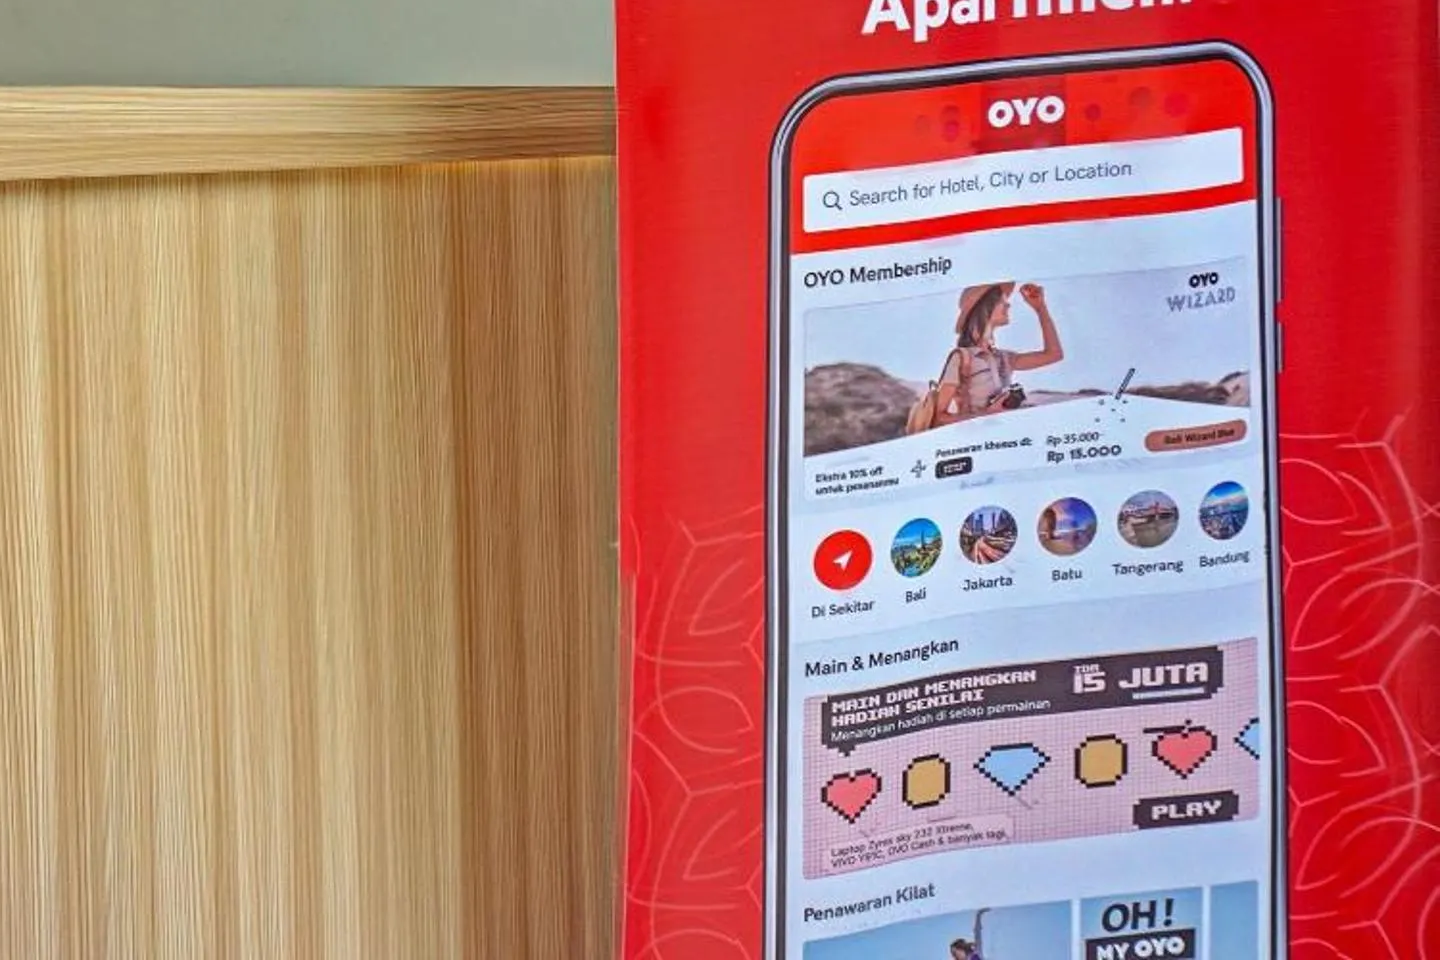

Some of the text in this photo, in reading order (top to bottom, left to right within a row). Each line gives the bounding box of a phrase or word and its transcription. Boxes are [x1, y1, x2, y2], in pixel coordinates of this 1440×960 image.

[988, 95, 1065, 128] OYO
[849, 162, 1133, 207] Search for Hotel, City or Location
[803, 256, 953, 289] OYO Membership
[1188, 272, 1220, 289] OYO
[1165, 286, 1237, 313] WIZARD
[1047, 450, 1065, 464] Rp
[1112, 558, 1184, 577] Tangerang
[1199, 549, 1251, 568] Bandung
[962, 575, 1013, 592] Jakarta
[1051, 569, 1083, 582] Batu
[905, 588, 927, 604] Bali
[811, 600, 876, 619] Di Sekitar
[804, 639, 960, 678] Main & Menangkan
[1072, 662, 1209, 694] 15 JUTA
[831, 669, 1038, 713] MAIN DAN MENANGKAN
[831, 688, 985, 728] HADIAH SENILAI
[830, 699, 1051, 743] Menangkan hadiah di setiap permainan
[1151, 800, 1222, 820] PLAY
[803, 883, 936, 922] Penawaran Kilat
[1096, 936, 1185, 960] MY OYO
